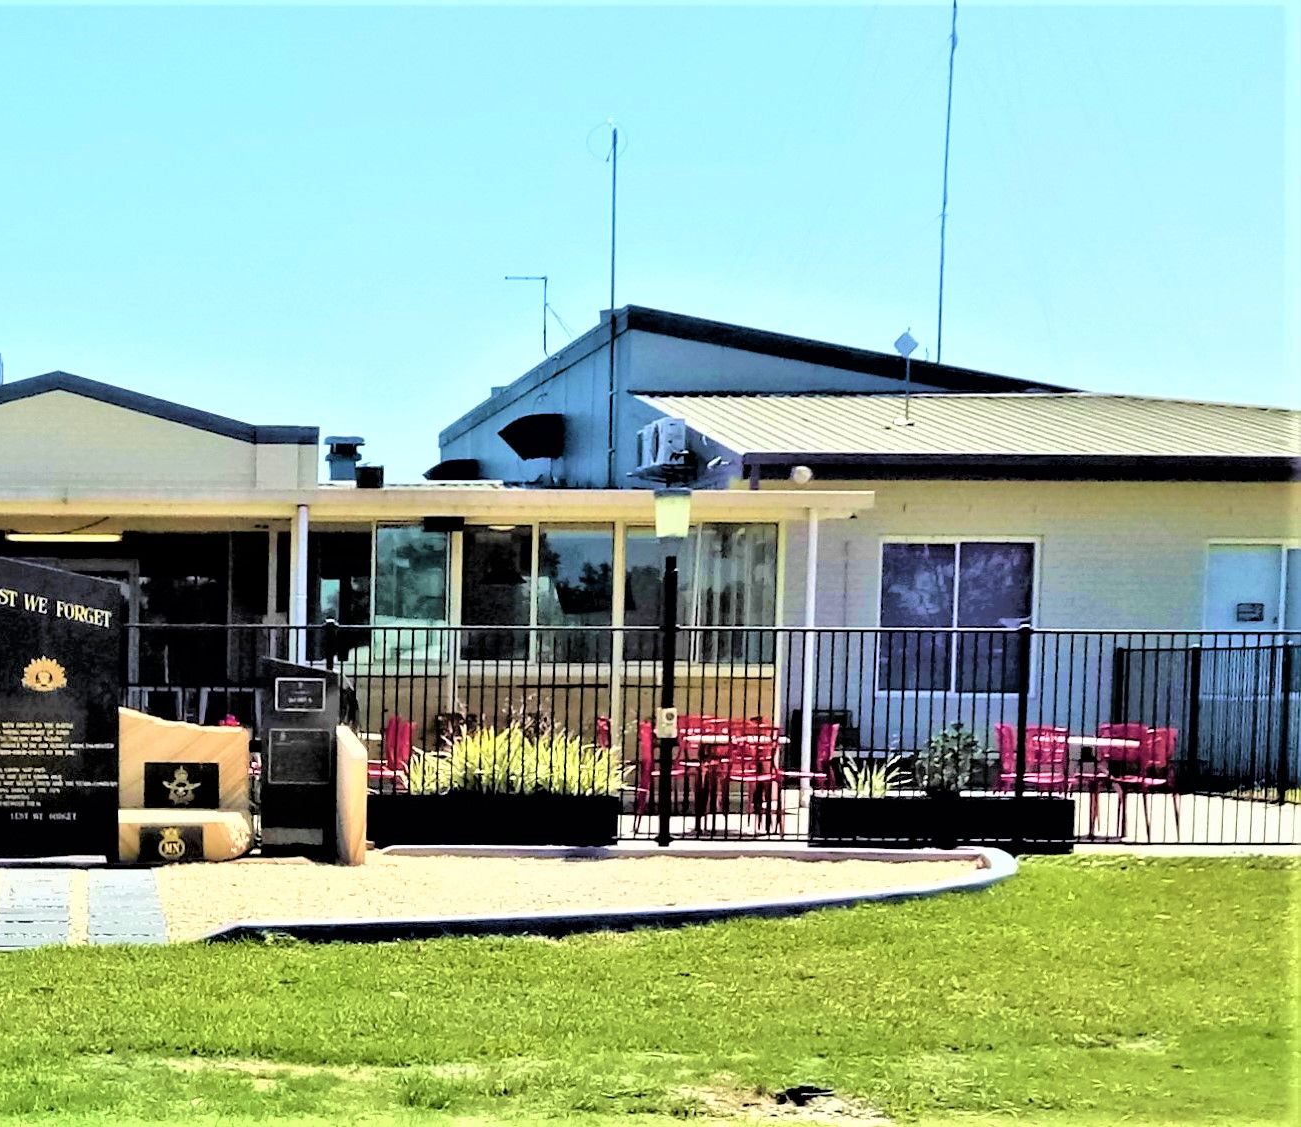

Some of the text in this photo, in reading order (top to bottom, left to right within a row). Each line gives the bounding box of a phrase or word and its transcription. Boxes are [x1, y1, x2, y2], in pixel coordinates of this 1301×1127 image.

[24, 593, 48, 614] WE
[56, 601, 112, 628] FORGET
[163, 843, 180, 853] MN
